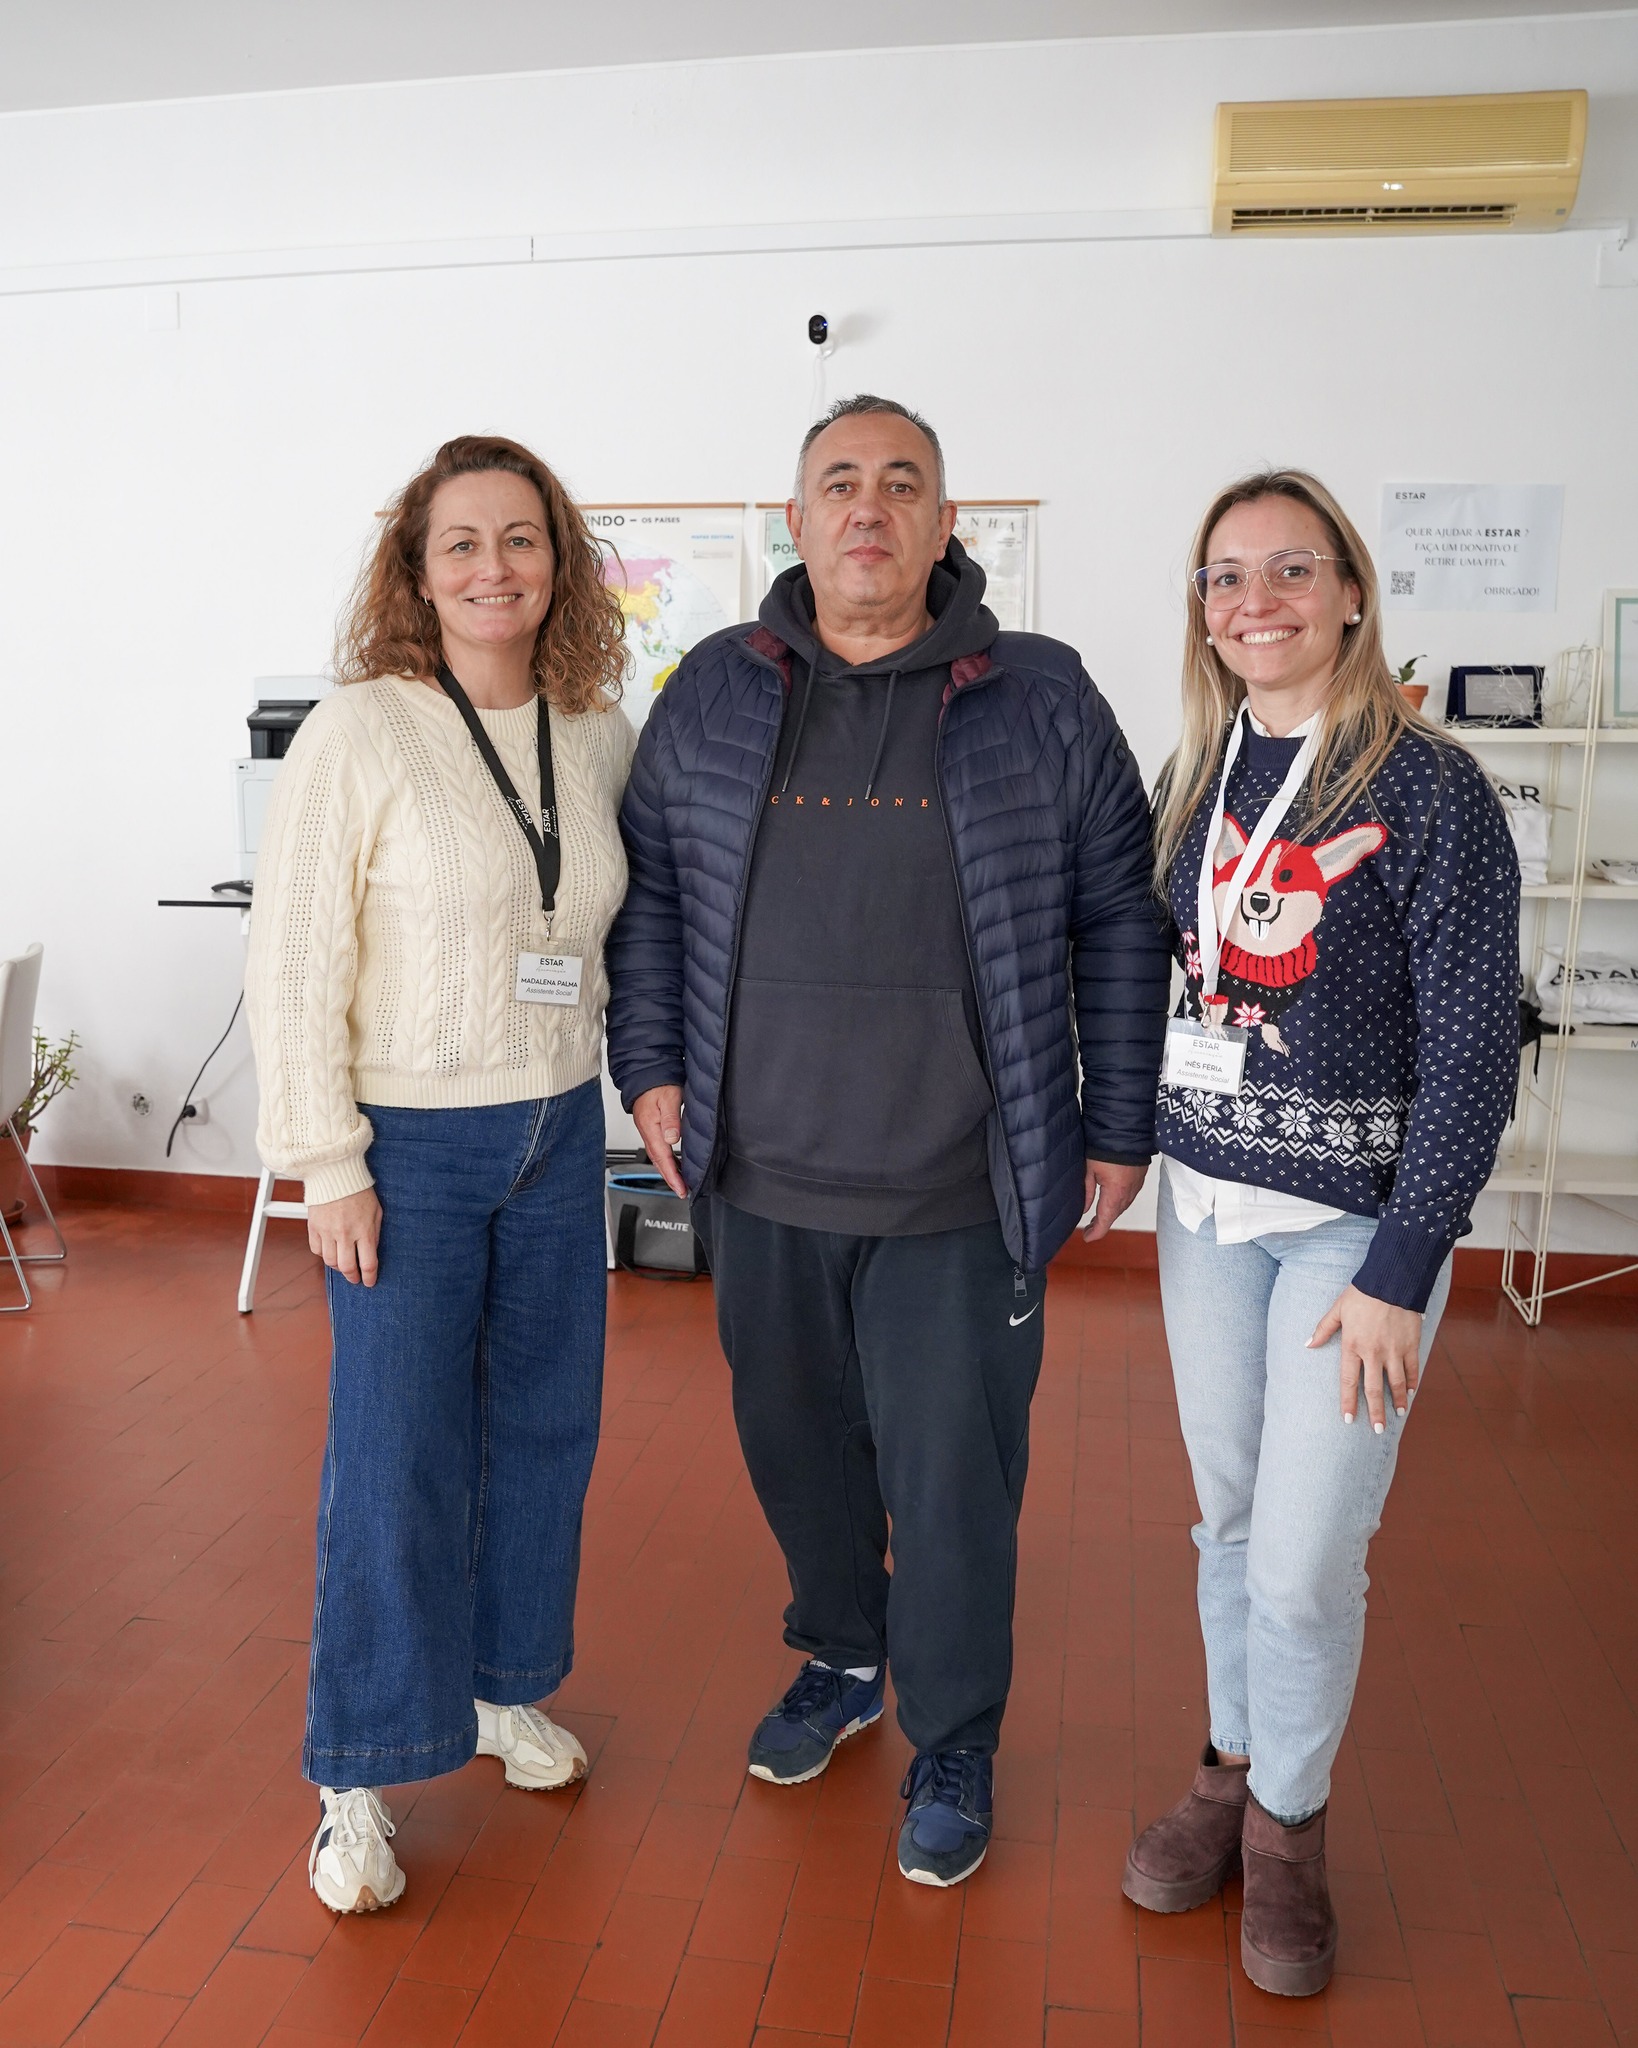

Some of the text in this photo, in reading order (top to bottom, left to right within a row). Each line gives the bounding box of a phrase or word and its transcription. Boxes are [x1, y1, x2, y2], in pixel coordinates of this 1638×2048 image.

[1395, 492, 1426, 500] ESTAR
[1405, 527, 1432, 538] QUER
[1434, 527, 1473, 538] AJUDAR
[1475, 528, 1483, 537] A
[1484, 528, 1521, 538] ESTAR
[1414, 543, 1440, 553] FAÇA
[1441, 543, 1458, 552] UM
[1459, 543, 1511, 552] DONATIVO
[1424, 557, 1455, 567] RETIRE
[1459, 557, 1483, 567] UMA
[1483, 586, 1540, 597] OBRIGADO!
[515, 798, 533, 824] ESTAR
[542, 808, 551, 833] ESTAR
[539, 957, 564, 967] ESTAR
[520, 977, 578, 988] MADALENA PALMA
[525, 987, 573, 997] Assistente Social
[1193, 1040, 1220, 1050] ESTAR
[1185, 1060, 1201, 1069] INÊS
[1177, 1069, 1229, 1083] Assistente Social
[644, 1218, 690, 1232] NANLITE
